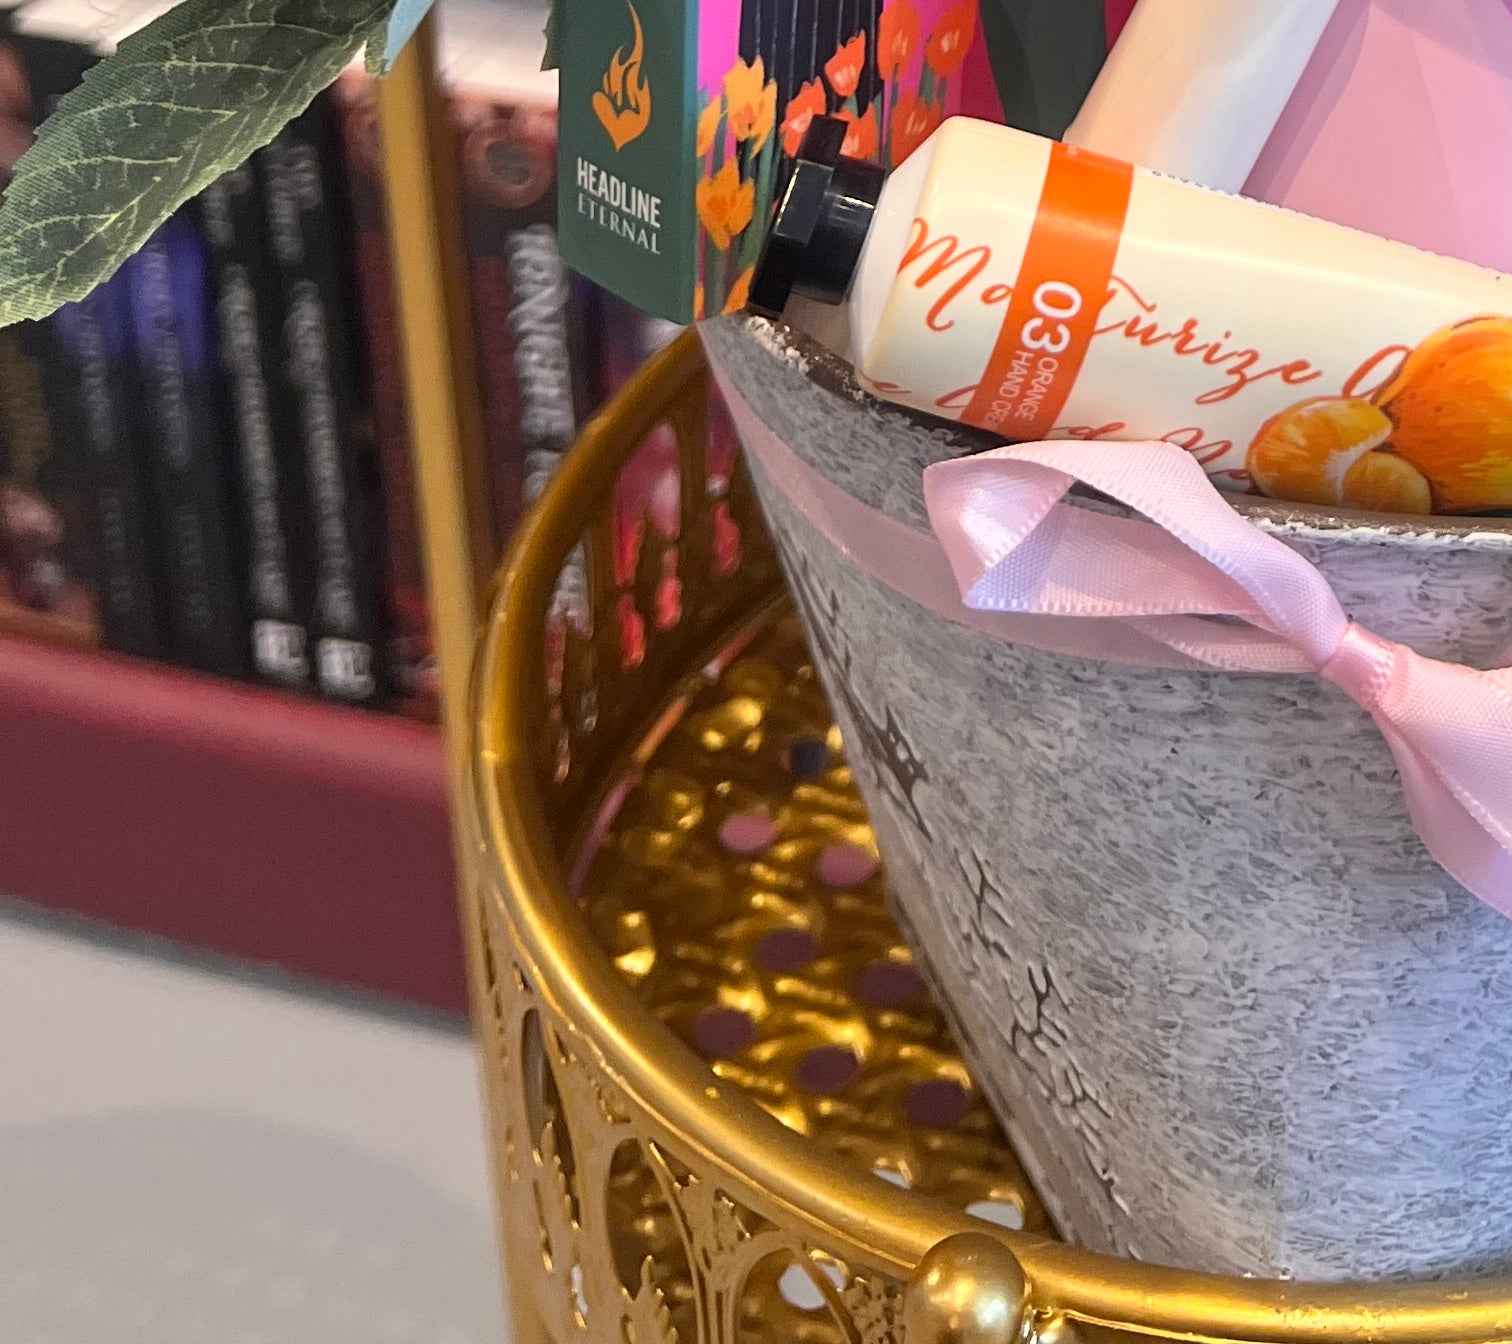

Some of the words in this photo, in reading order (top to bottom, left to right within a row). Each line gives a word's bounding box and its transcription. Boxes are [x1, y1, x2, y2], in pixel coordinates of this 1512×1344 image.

[577, 156, 661, 228] HEADLINE
[577, 192, 661, 255] ETERNAL
[1021, 280, 1082, 353] 03
[999, 349, 1036, 399] HAND
[1015, 356, 1059, 422] ORANGE
